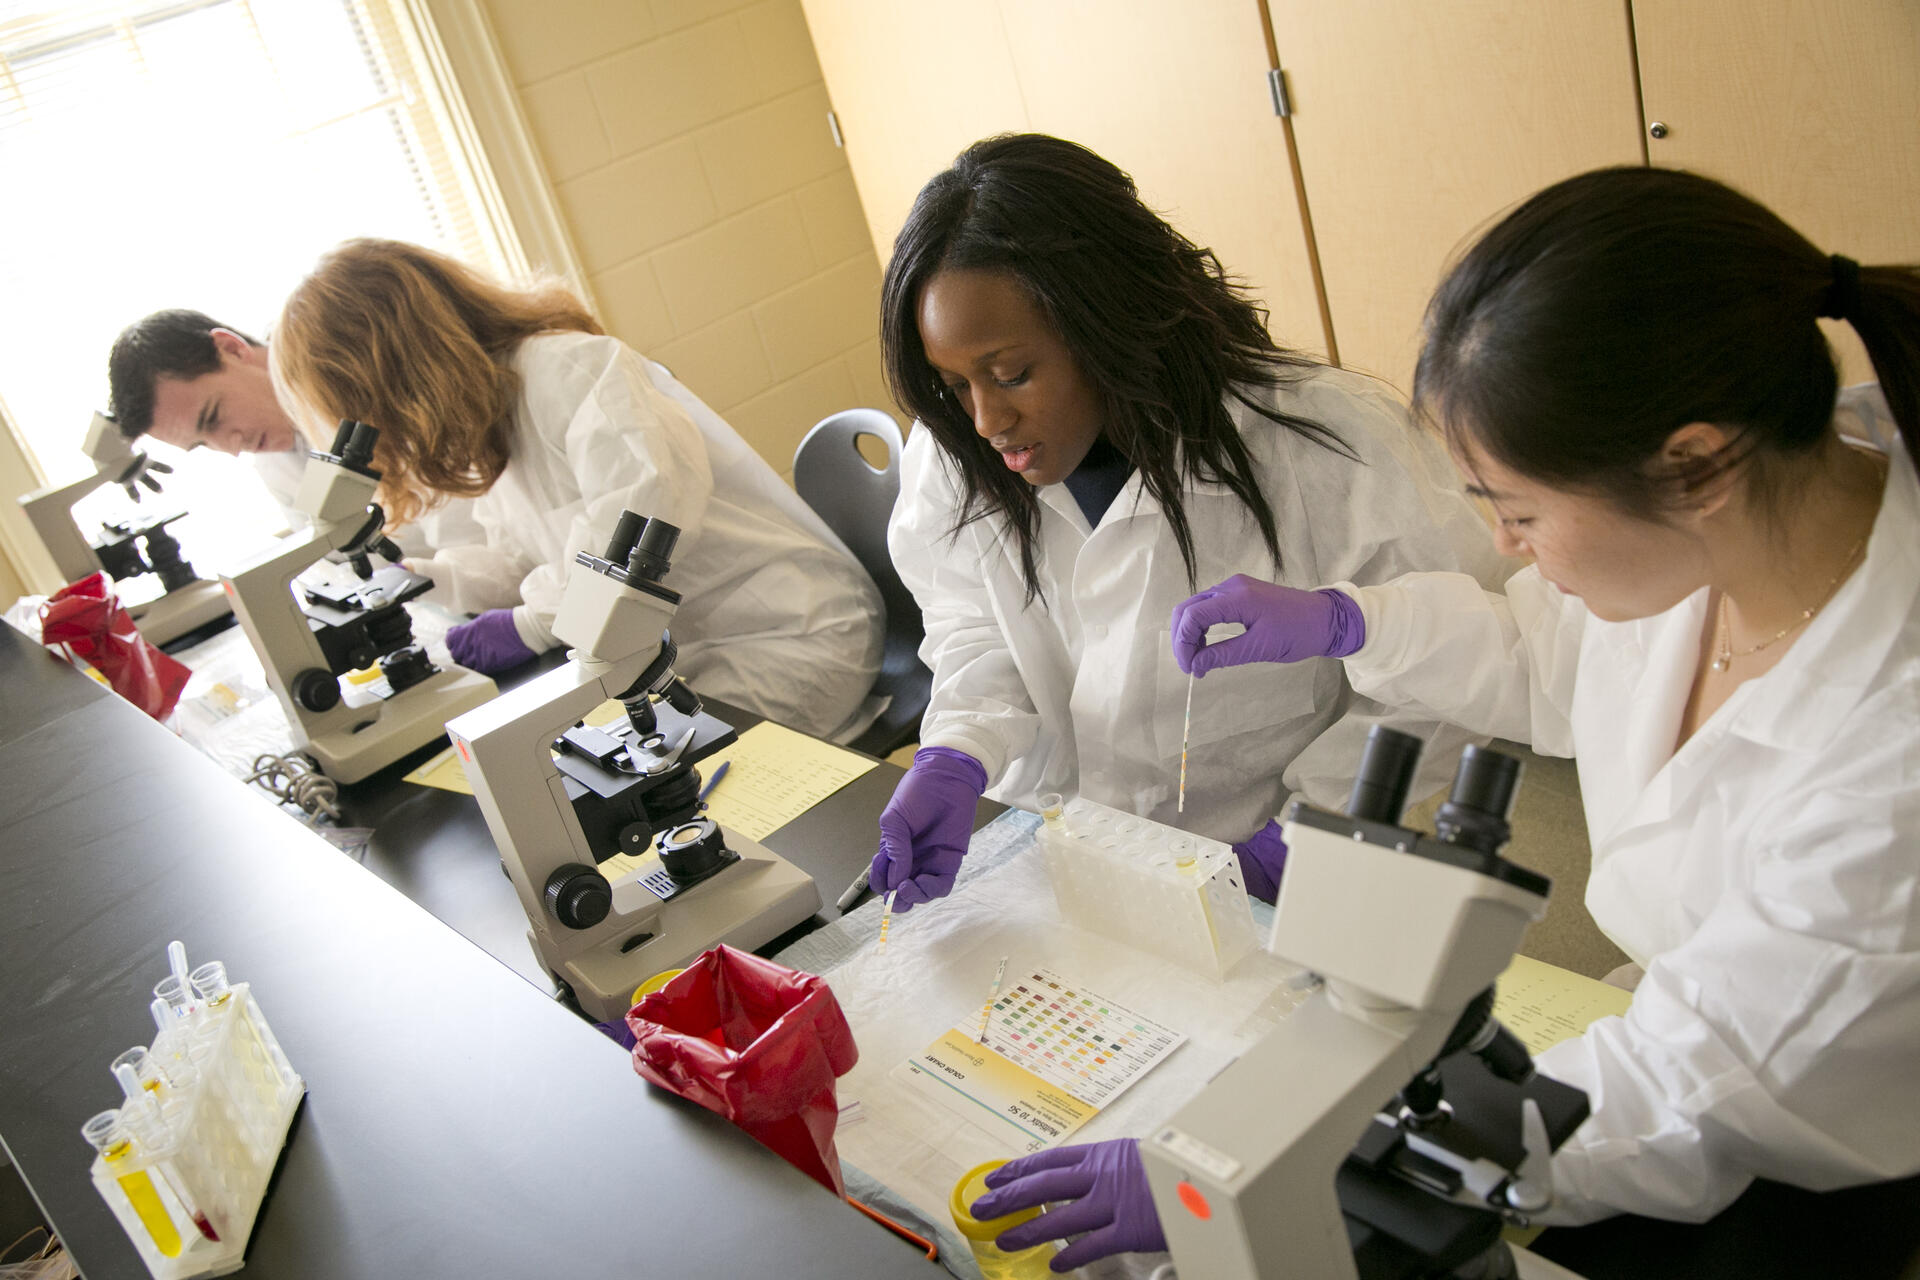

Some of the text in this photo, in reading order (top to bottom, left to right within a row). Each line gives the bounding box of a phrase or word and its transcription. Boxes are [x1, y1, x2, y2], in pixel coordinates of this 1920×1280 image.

[925, 1054, 965, 1080] COLOR CHART
[1008, 1105, 1021, 1115] SG
[1019, 1111, 1030, 1120] 10
